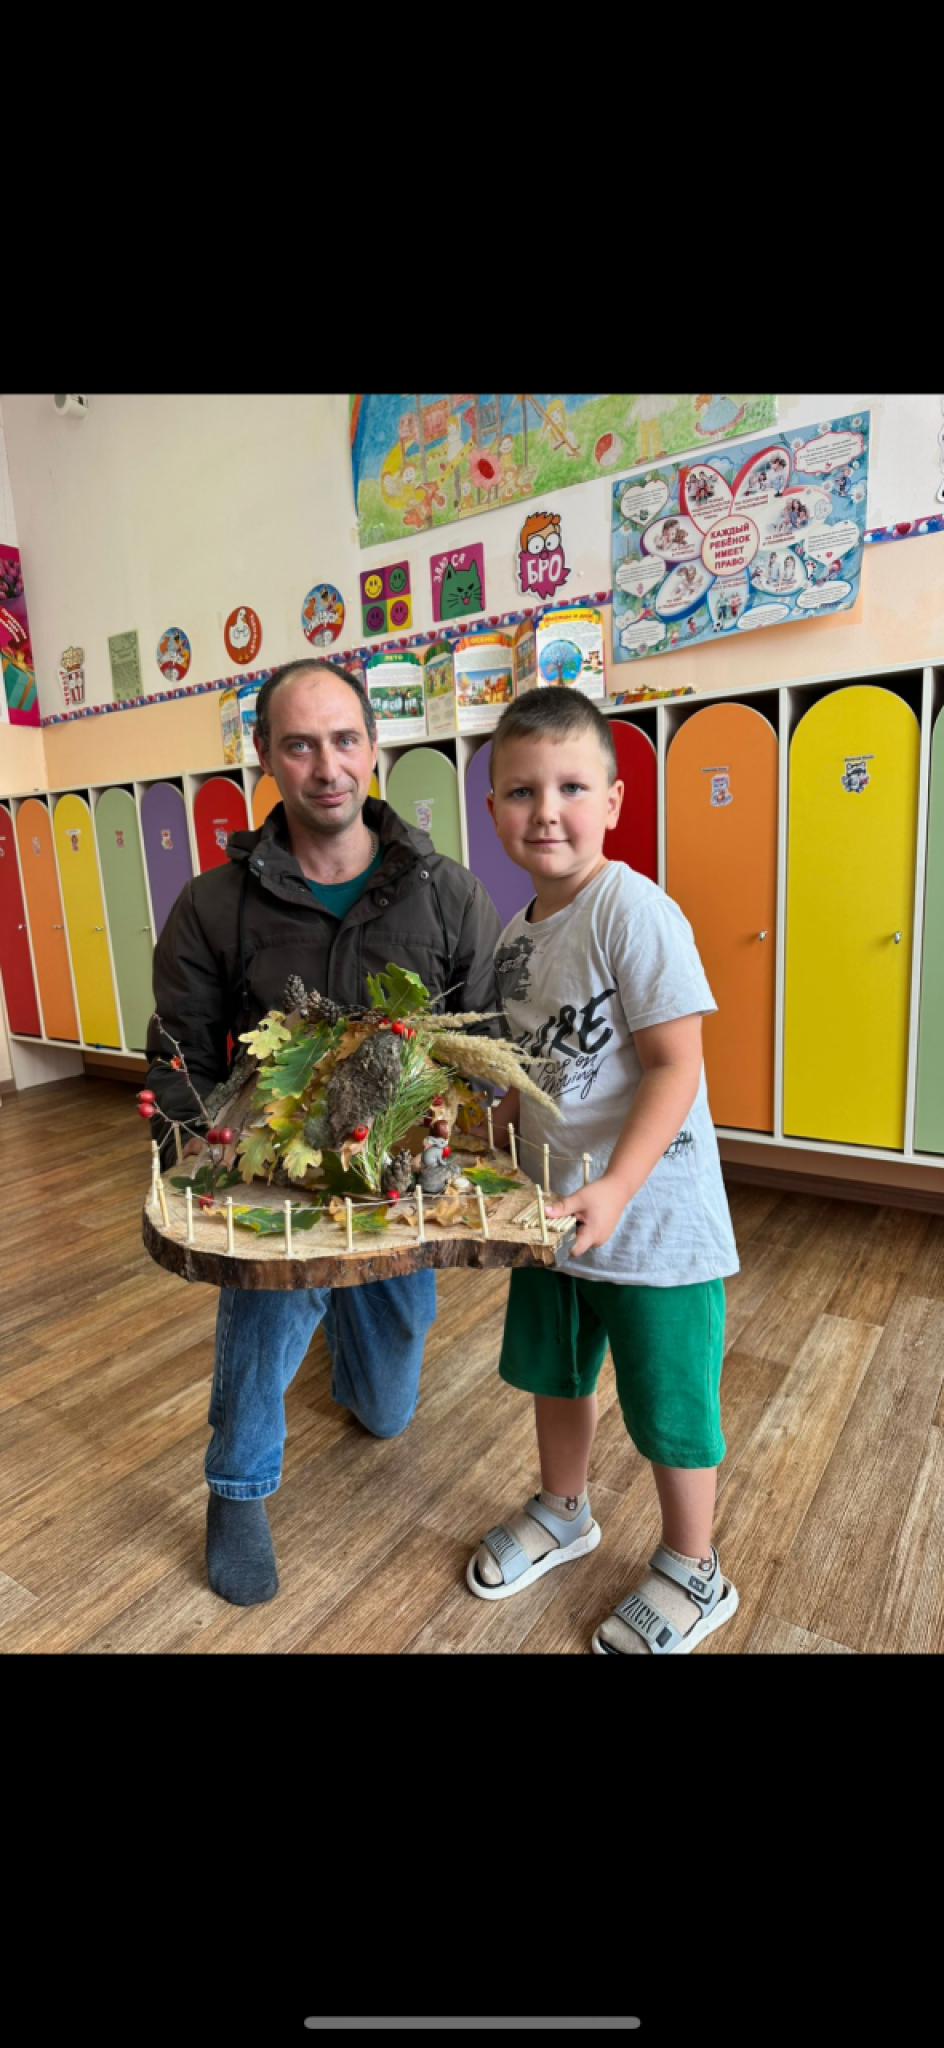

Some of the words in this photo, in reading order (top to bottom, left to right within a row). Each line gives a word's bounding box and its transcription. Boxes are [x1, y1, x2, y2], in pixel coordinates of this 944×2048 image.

[710, 522, 750, 539] КАЖДЫЙ
[714, 546, 744, 559] ИМЕЕТ
[527, 554, 561, 585] БРО
[384, 653, 403, 662] ЛЕТО
